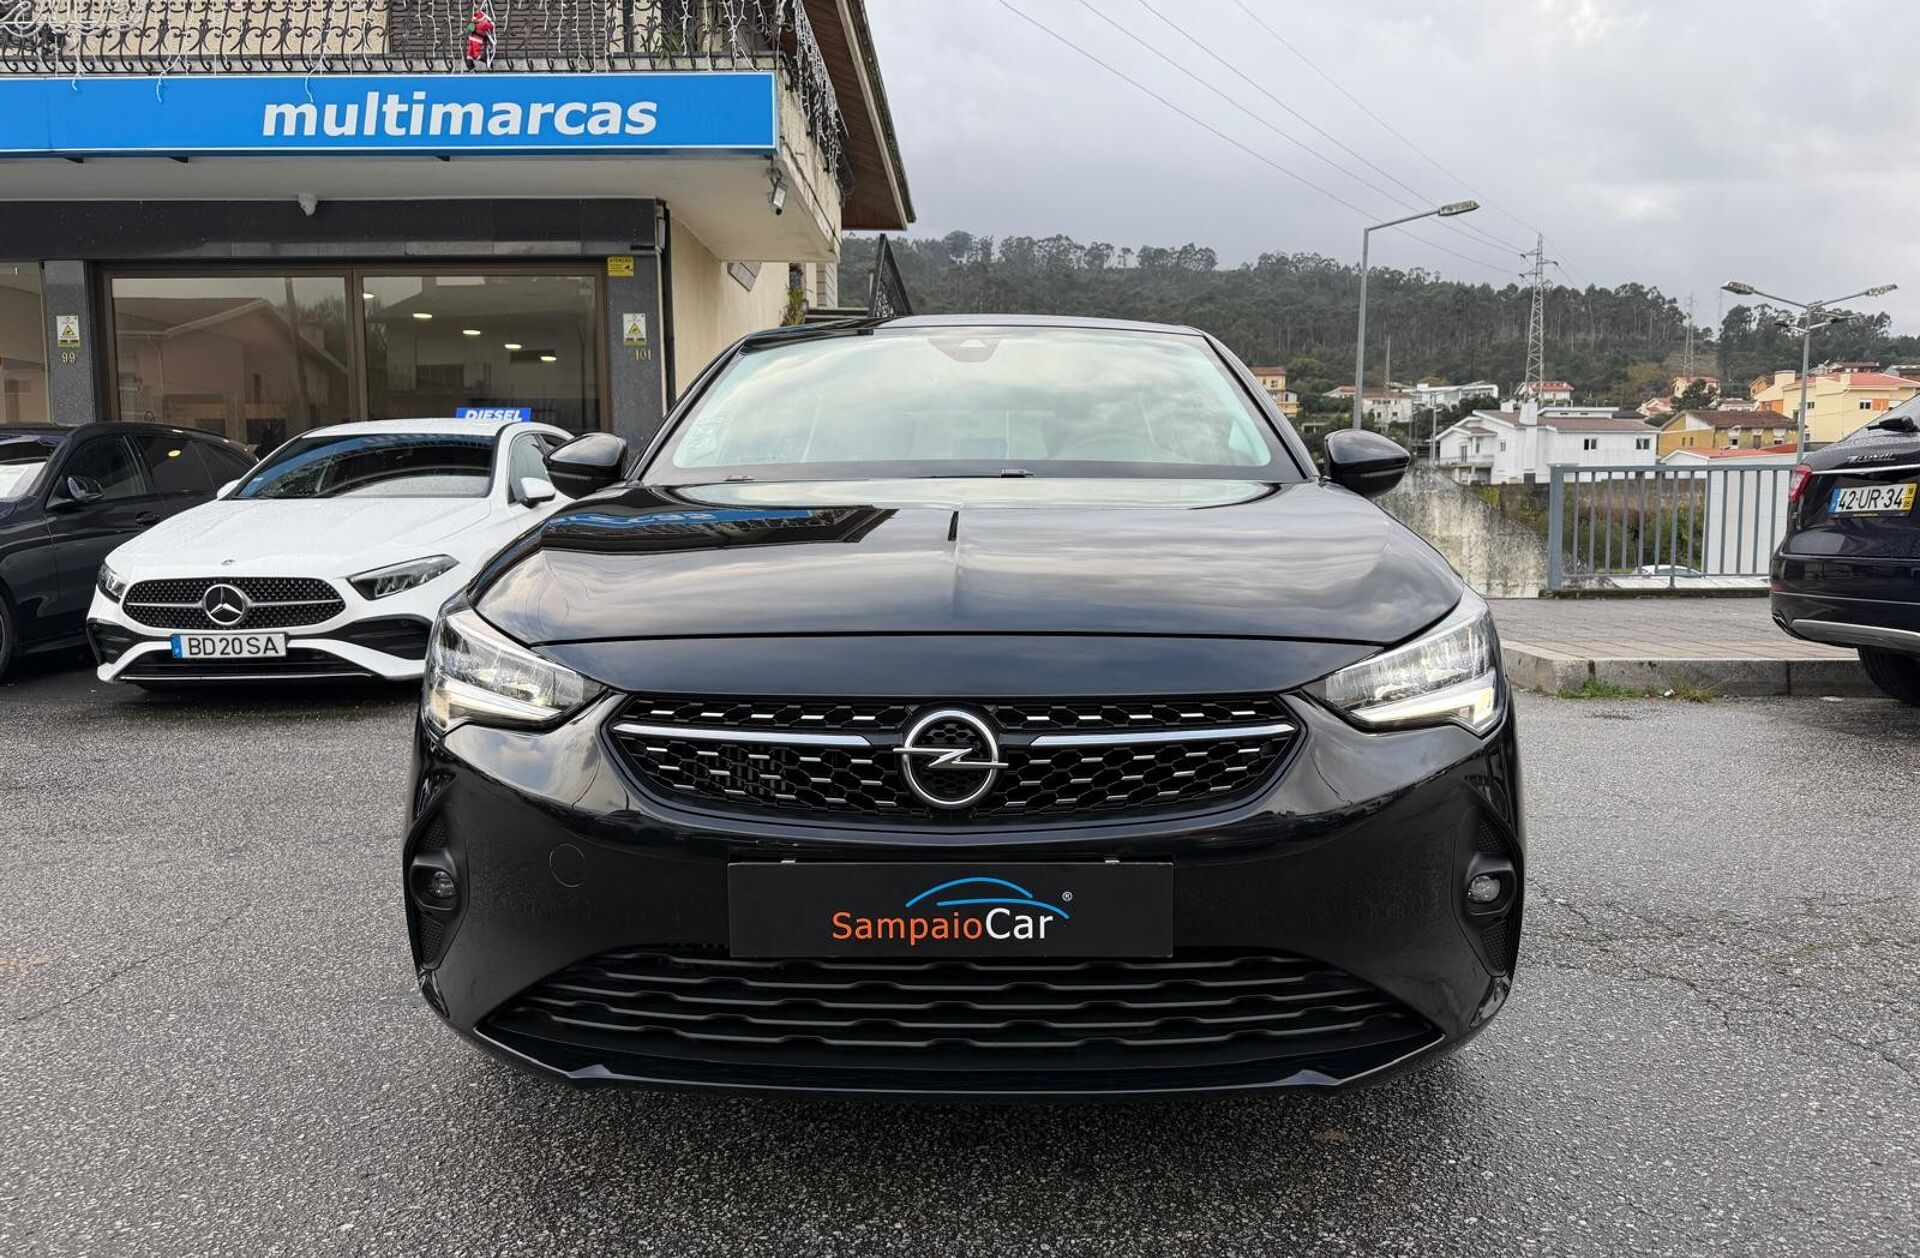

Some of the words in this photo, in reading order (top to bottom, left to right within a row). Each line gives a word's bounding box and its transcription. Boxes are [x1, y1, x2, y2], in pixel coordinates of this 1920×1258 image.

[262, 91, 658, 137] multimarcas
[465, 409, 523, 421] DIESEL
[831, 908, 1053, 946] SampaioCar
